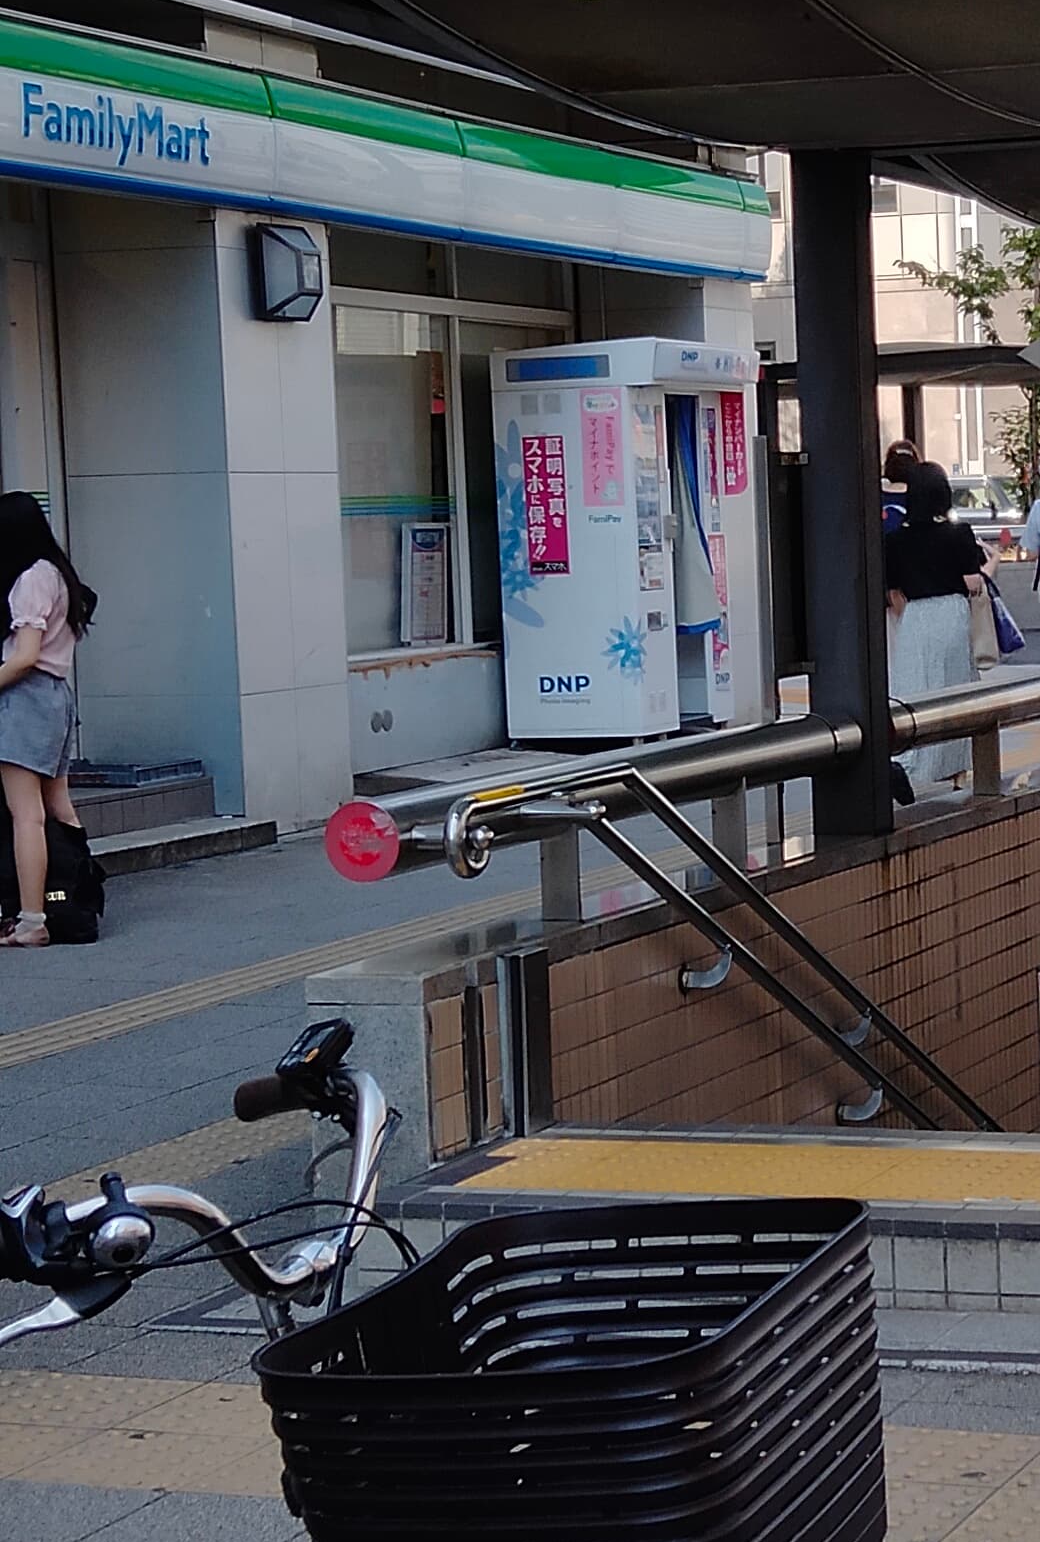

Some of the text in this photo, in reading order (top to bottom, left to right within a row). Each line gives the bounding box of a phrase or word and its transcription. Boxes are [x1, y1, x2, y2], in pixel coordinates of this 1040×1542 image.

[21, 81, 211, 166] FamilyMart
[545, 437, 566, 528] 証明写真を
[539, 675, 590, 694] DNP
